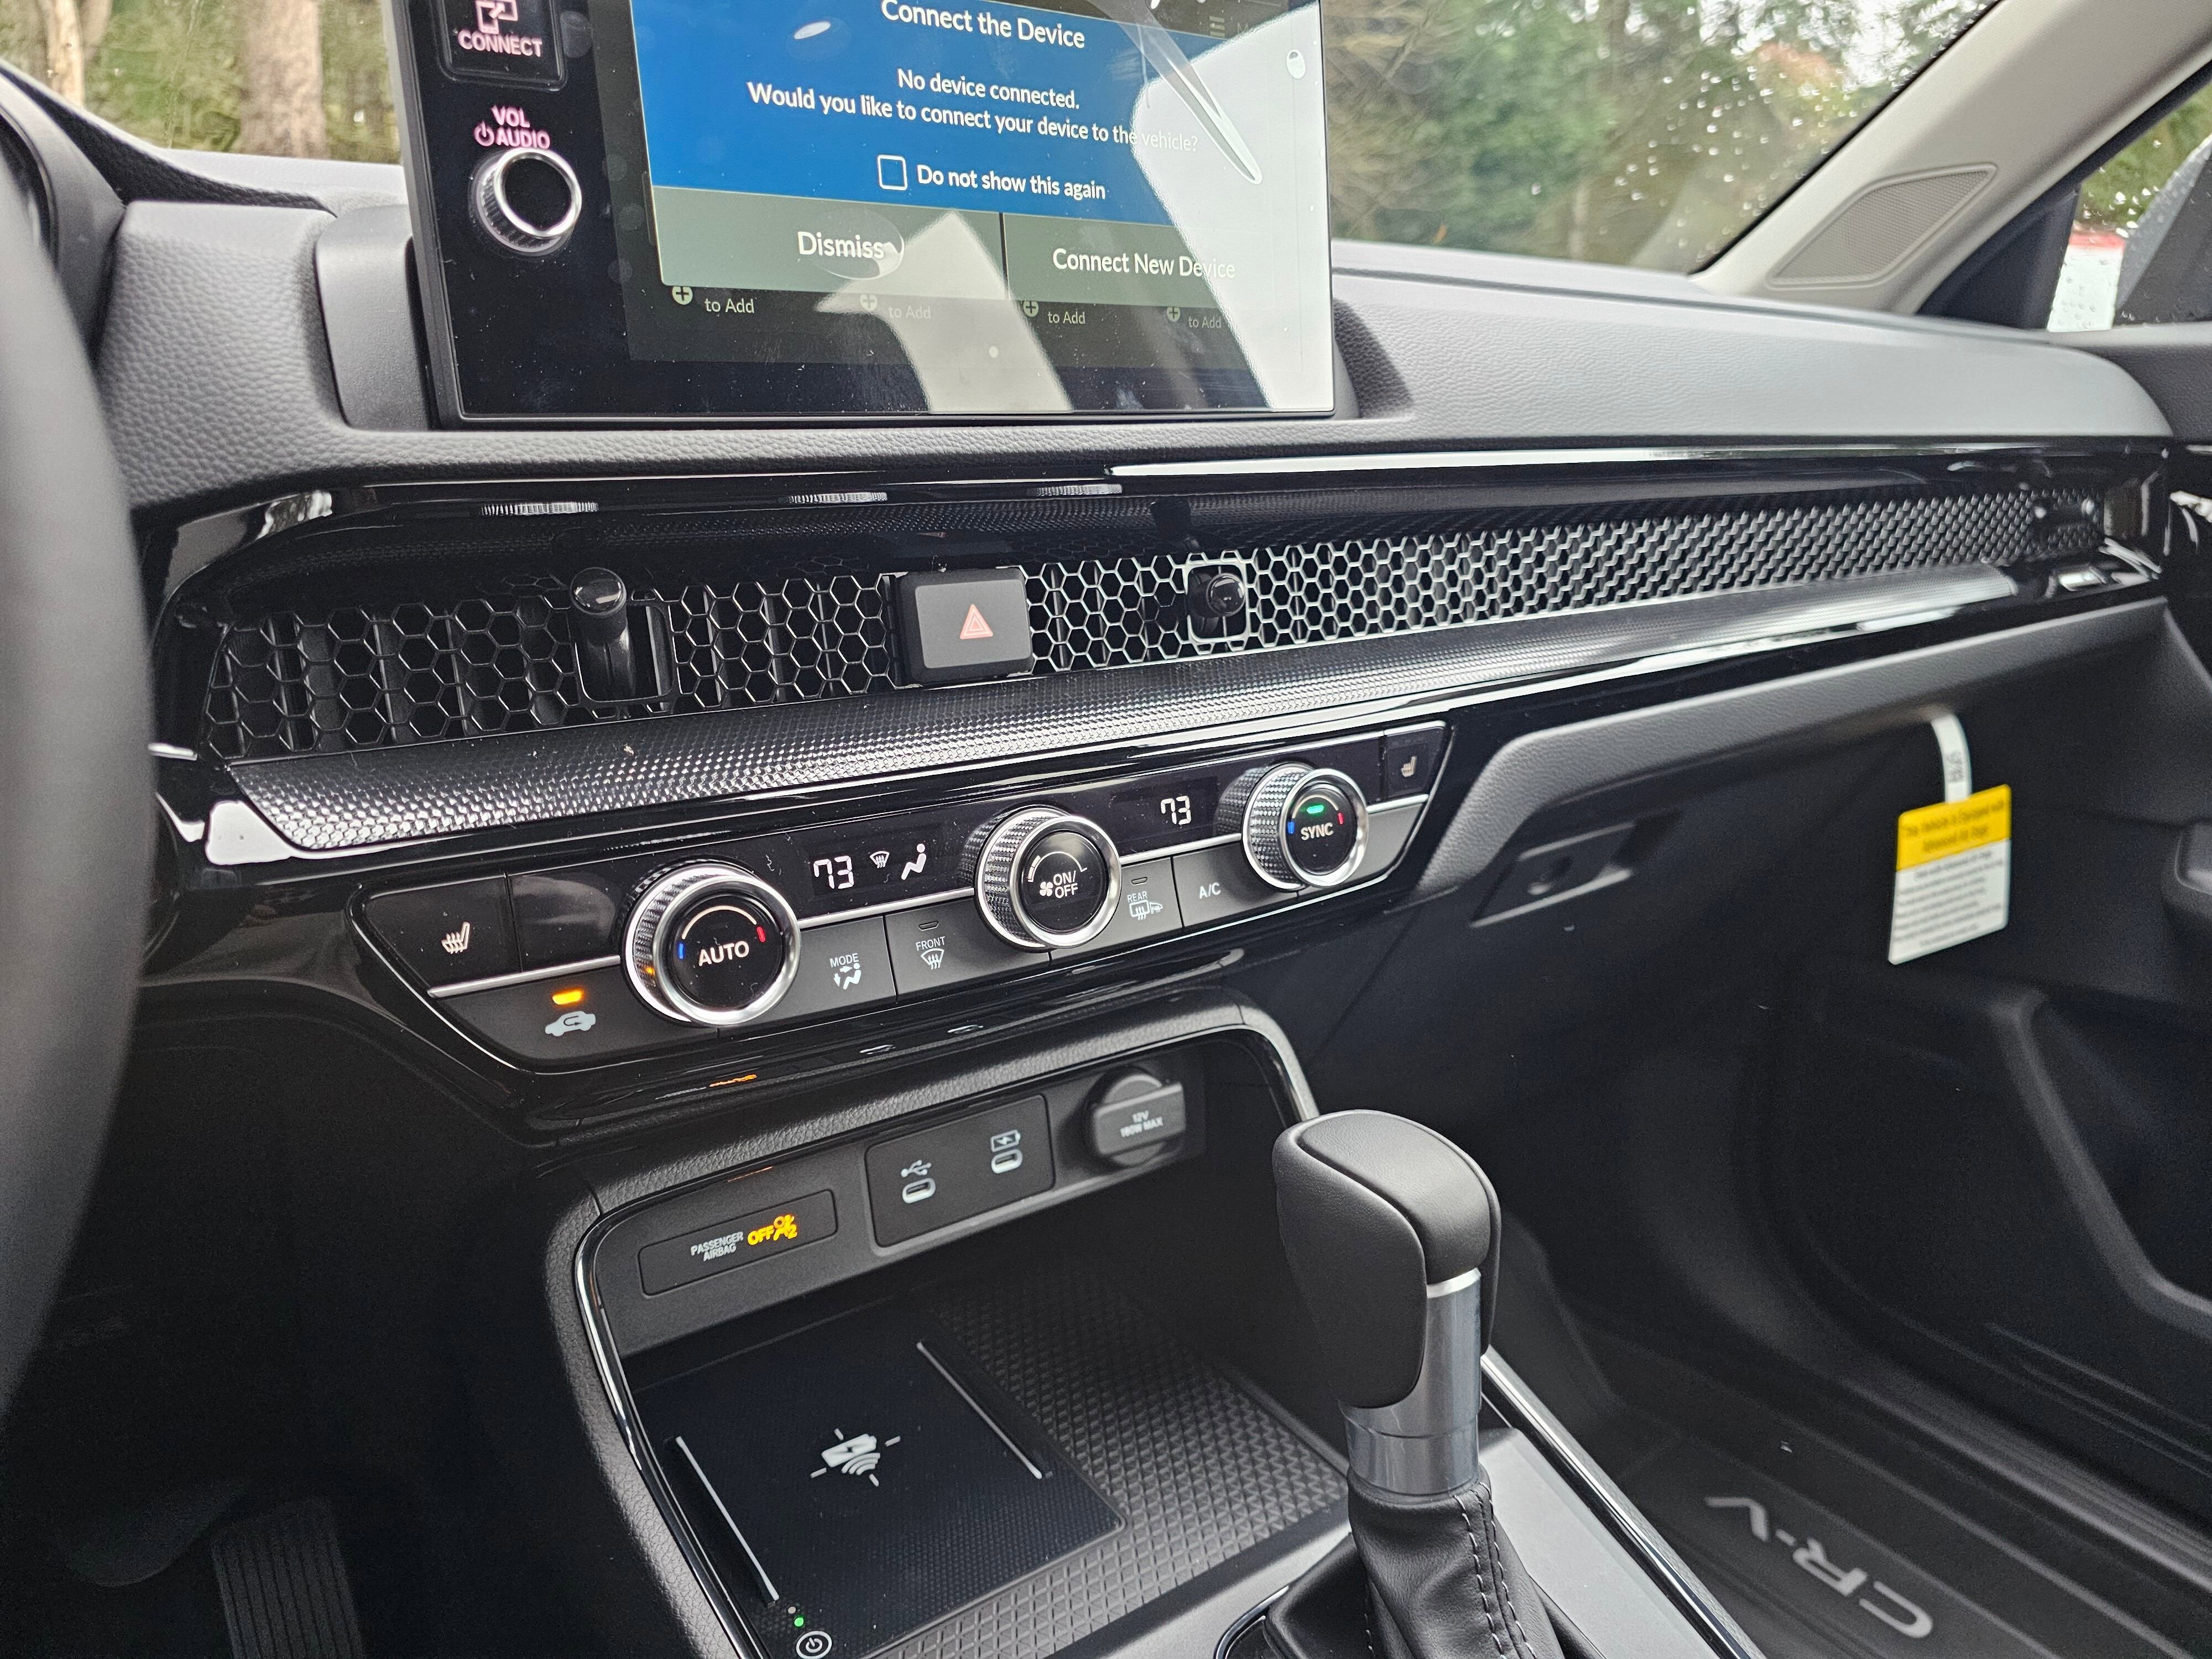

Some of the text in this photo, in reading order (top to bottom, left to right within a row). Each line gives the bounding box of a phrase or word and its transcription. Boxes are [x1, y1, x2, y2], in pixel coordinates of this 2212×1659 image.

[881, 0, 1085, 48] Connect the Device
[458, 29, 542, 57] CONNECT
[898, 68, 1079, 109] No device connected.
[491, 105, 530, 128] VOL
[747, 81, 1198, 152] Would you like to connect your device to the vehicle?
[495, 127, 550, 149] AUDIO
[917, 164, 1105, 201] Do not show this again
[797, 231, 885, 259] Dismiss
[1053, 248, 1235, 278] Connect New Device
[705, 298, 754, 314] to Add
[889, 304, 931, 319] to Add
[1048, 311, 1086, 325] to Add
[1188, 315, 1222, 329] to Add
[1160, 795, 1192, 825] 73
[1301, 822, 1334, 841] SYNC
[813, 855, 854, 889] 73
[1053, 870, 1077, 886] ON/
[1055, 883, 1078, 898] OFF
[1127, 891, 1148, 903] REAR
[1199, 883, 1222, 899] A/C
[698, 940, 750, 967] AUTO
[915, 936, 946, 951] FRONT
[830, 953, 860, 968] MODE
[1143, 1117, 1163, 1130] MAX
[691, 1232, 744, 1256] PASSENGER
[748, 1225, 775, 1245] OFF
[704, 1243, 737, 1261] AIRBAG
[1704, 1496, 1932, 1639] CR-V
